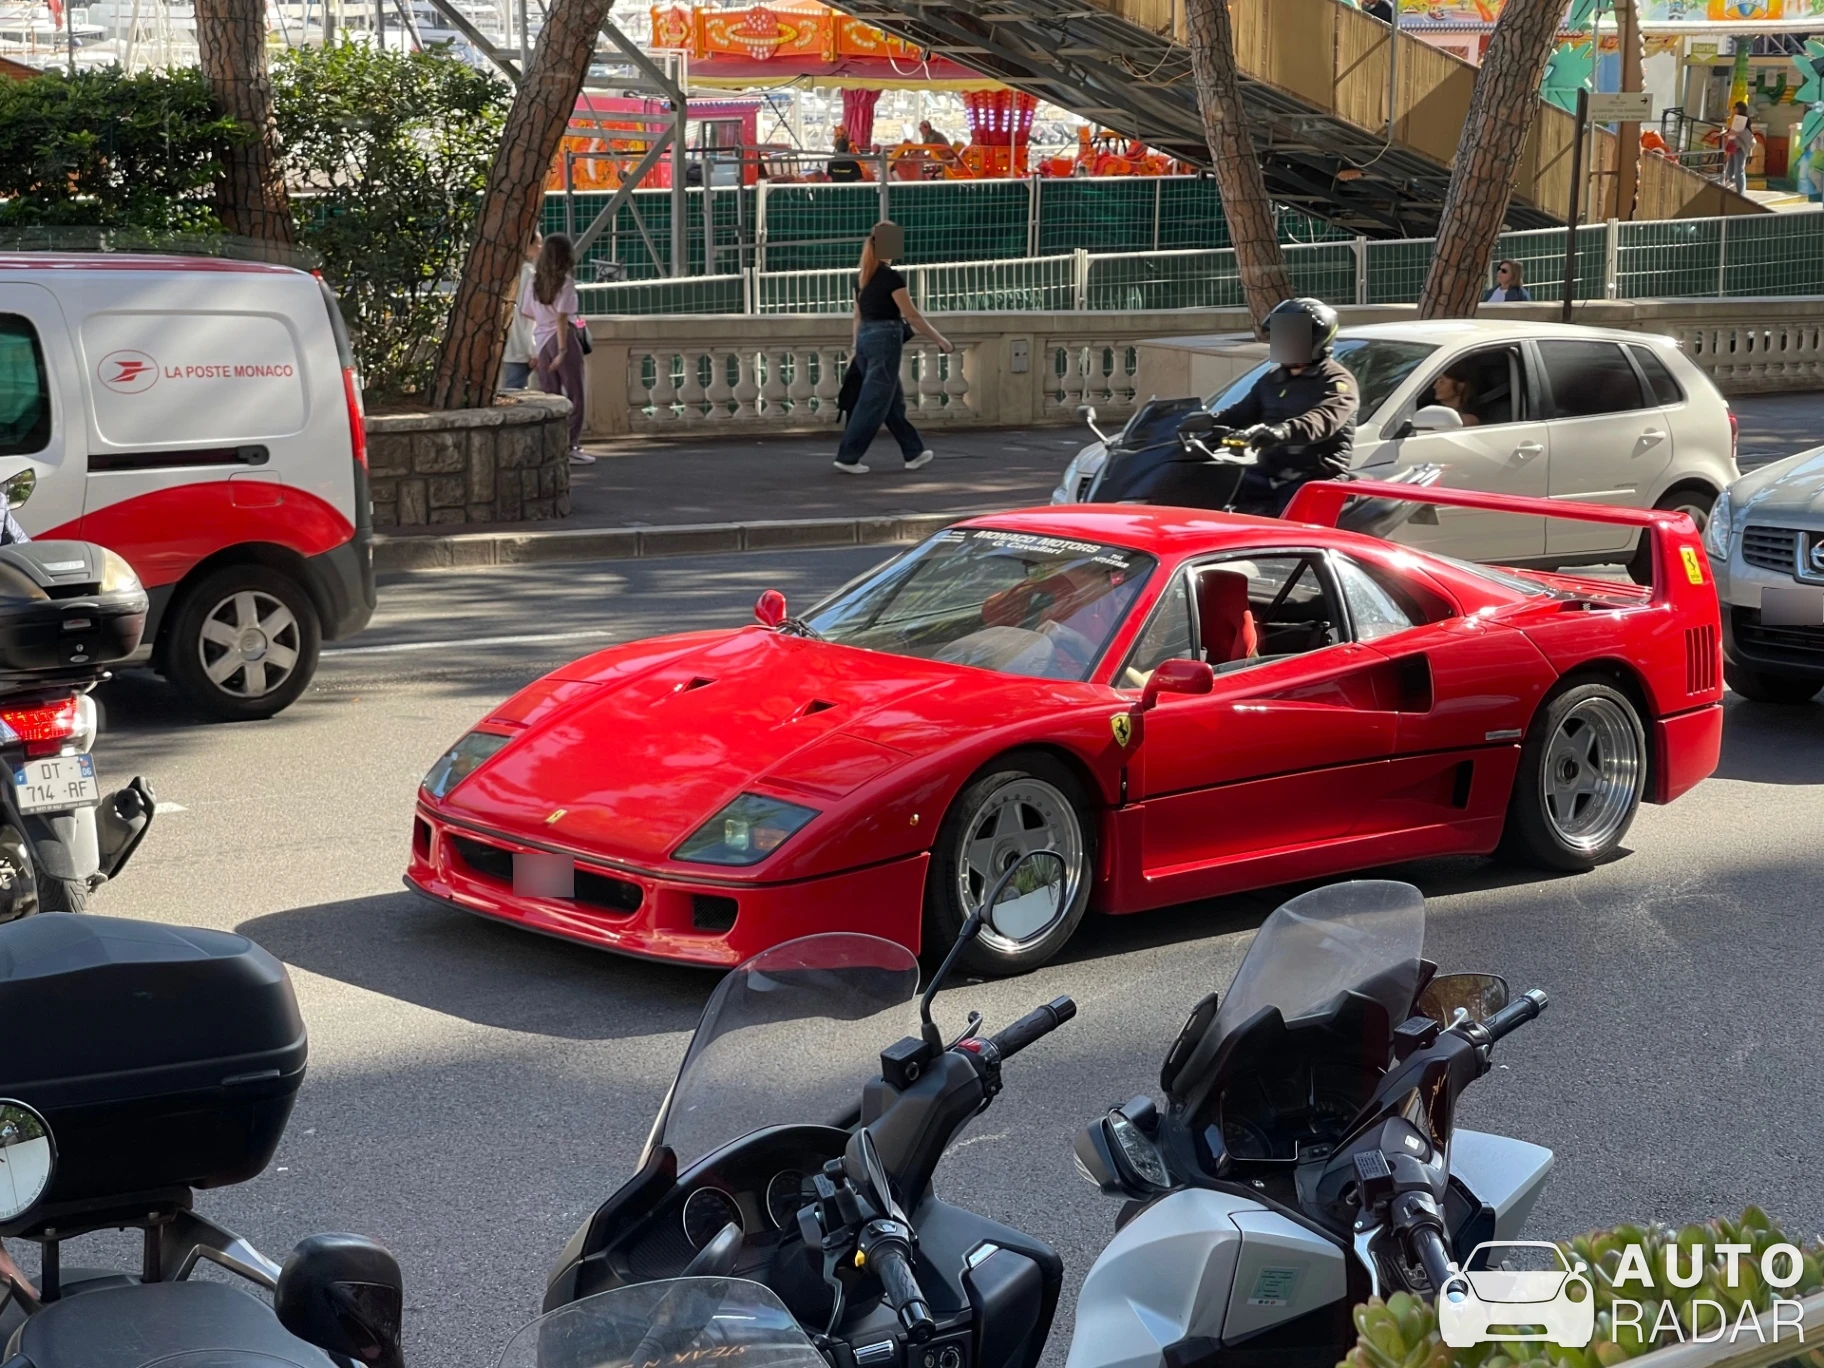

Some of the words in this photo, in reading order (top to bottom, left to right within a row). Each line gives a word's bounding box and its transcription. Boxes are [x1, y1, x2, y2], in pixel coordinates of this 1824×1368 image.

[164, 366, 183, 378] LA
[186, 365, 231, 378] POSTE
[234, 364, 293, 377] MONACO
[972, 530, 1035, 544] MONACO
[1037, 537, 1102, 553] MOTORS
[41, 762, 61, 780] DT
[26, 784, 55, 803] 714
